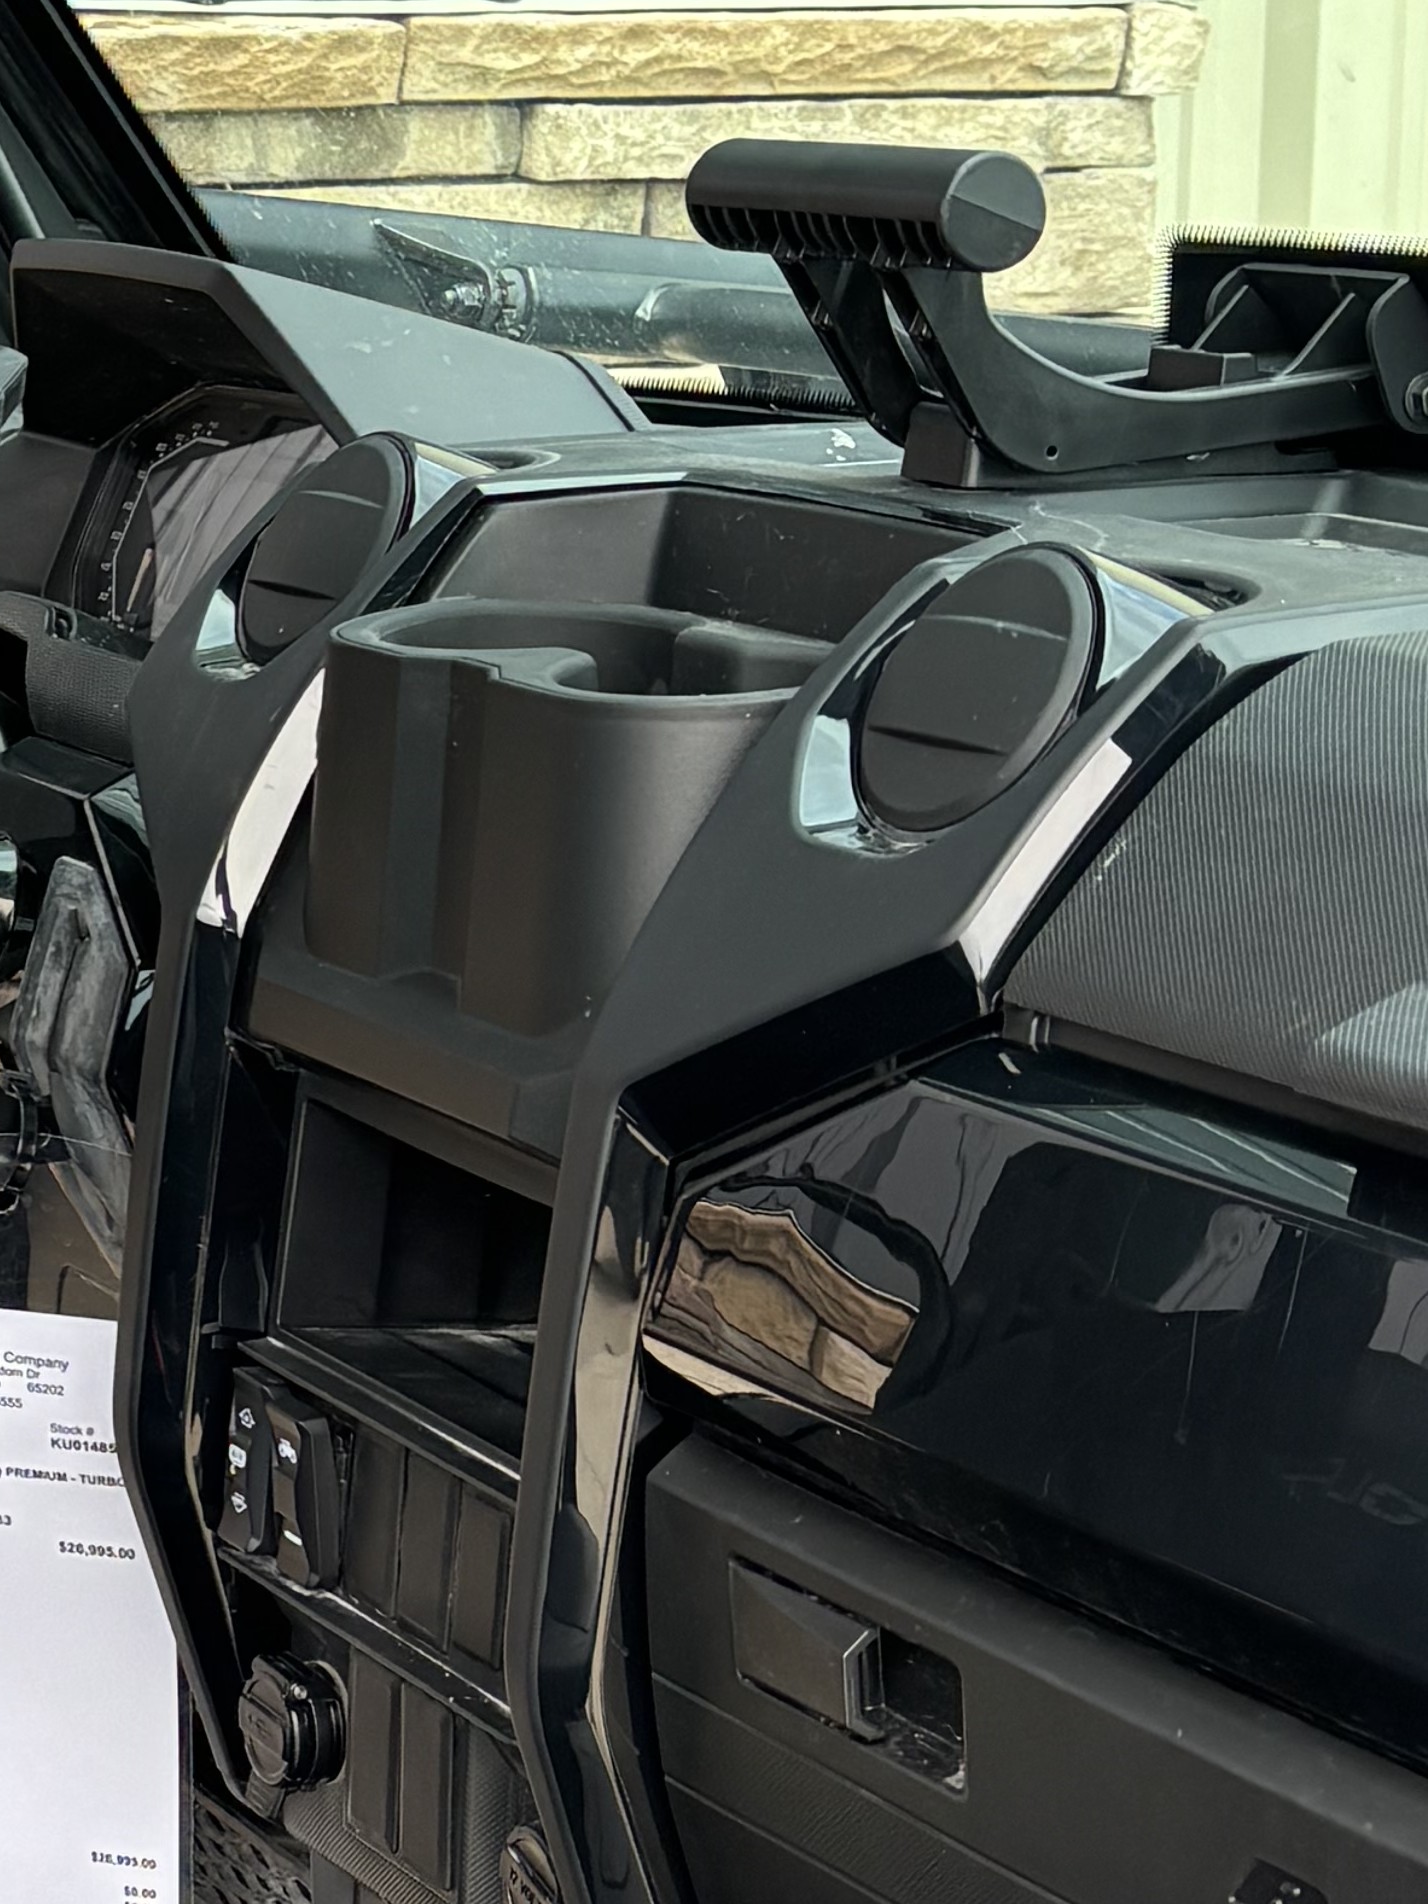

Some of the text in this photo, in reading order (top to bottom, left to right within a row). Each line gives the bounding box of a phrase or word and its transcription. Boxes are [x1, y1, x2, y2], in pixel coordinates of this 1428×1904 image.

[3, 1350, 70, 1373] Company
[26, 1368, 41, 1380] Dr
[26, 1381, 65, 1396] 65202
[49, 1422, 83, 1437] Stock
